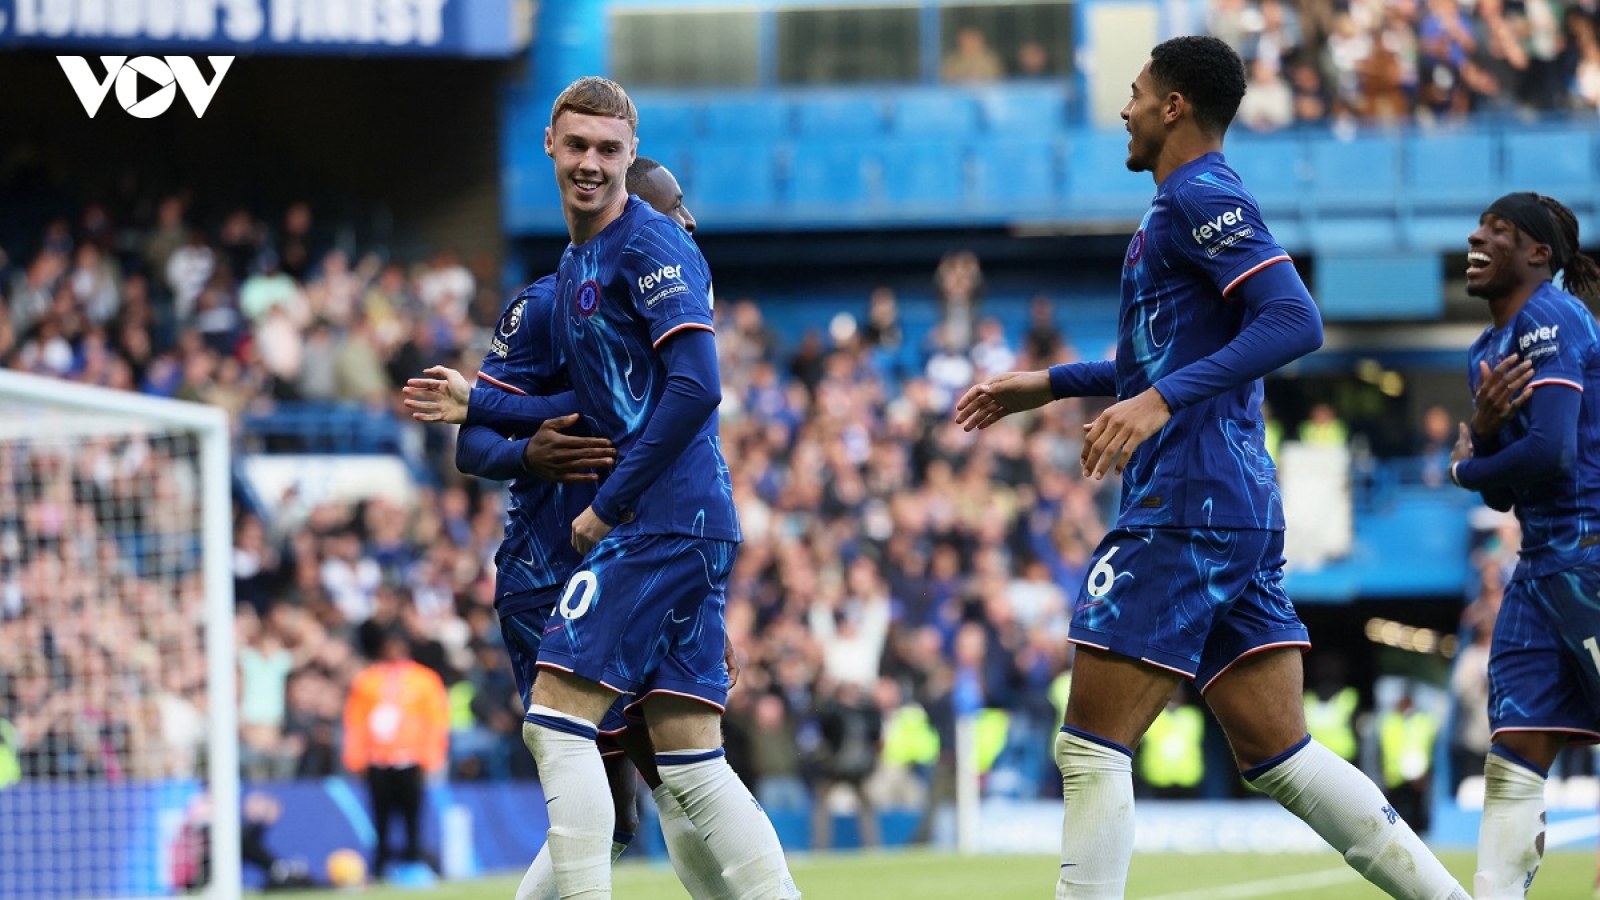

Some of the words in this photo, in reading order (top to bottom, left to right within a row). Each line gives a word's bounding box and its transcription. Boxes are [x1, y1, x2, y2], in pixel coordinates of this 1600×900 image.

[1192, 207, 1244, 245] fever
[638, 264, 682, 294] fever
[1088, 546, 1121, 597] 6
